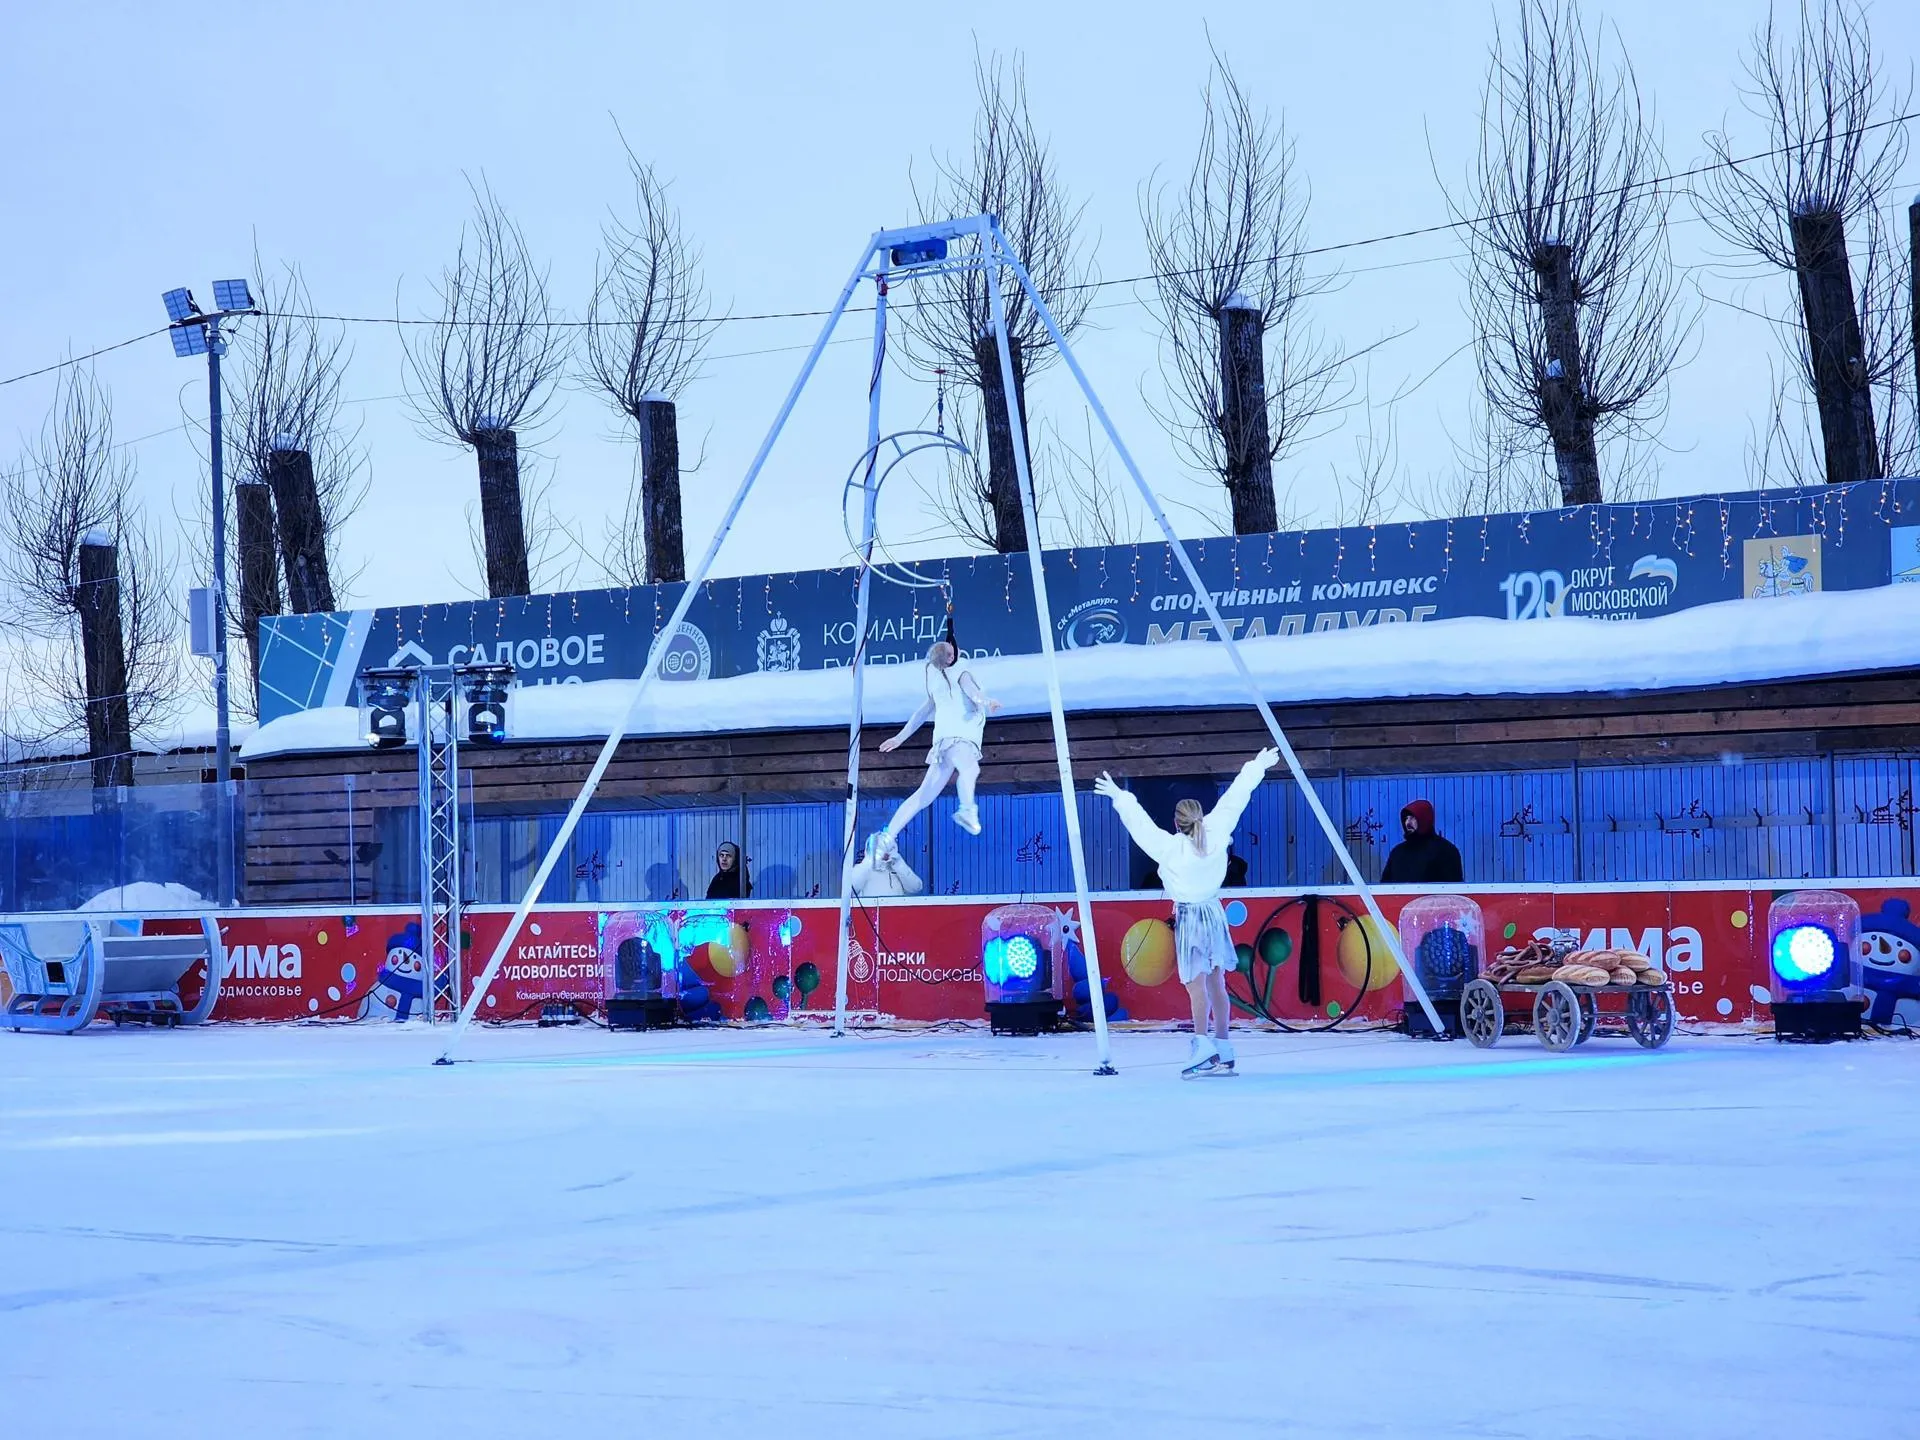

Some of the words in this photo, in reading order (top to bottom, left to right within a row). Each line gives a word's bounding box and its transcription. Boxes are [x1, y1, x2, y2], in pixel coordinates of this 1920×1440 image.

[1571, 566, 1616, 589] ОКРУГ
[1150, 580, 1302, 614] спортивный
[1312, 576, 1438, 601] комплекс
[1499, 571, 1565, 620] 120
[1571, 582, 1668, 612] МОСКОВСКОЙ
[199, 943, 302, 979] има
[518, 941, 597, 960] КАТАЙТЕСЬ
[878, 952, 925, 965] ПАРКИ
[877, 968, 983, 982] ПОДМОСКОВЬ
[219, 985, 302, 998] одмосковье
[516, 991, 550, 1000] Команда
